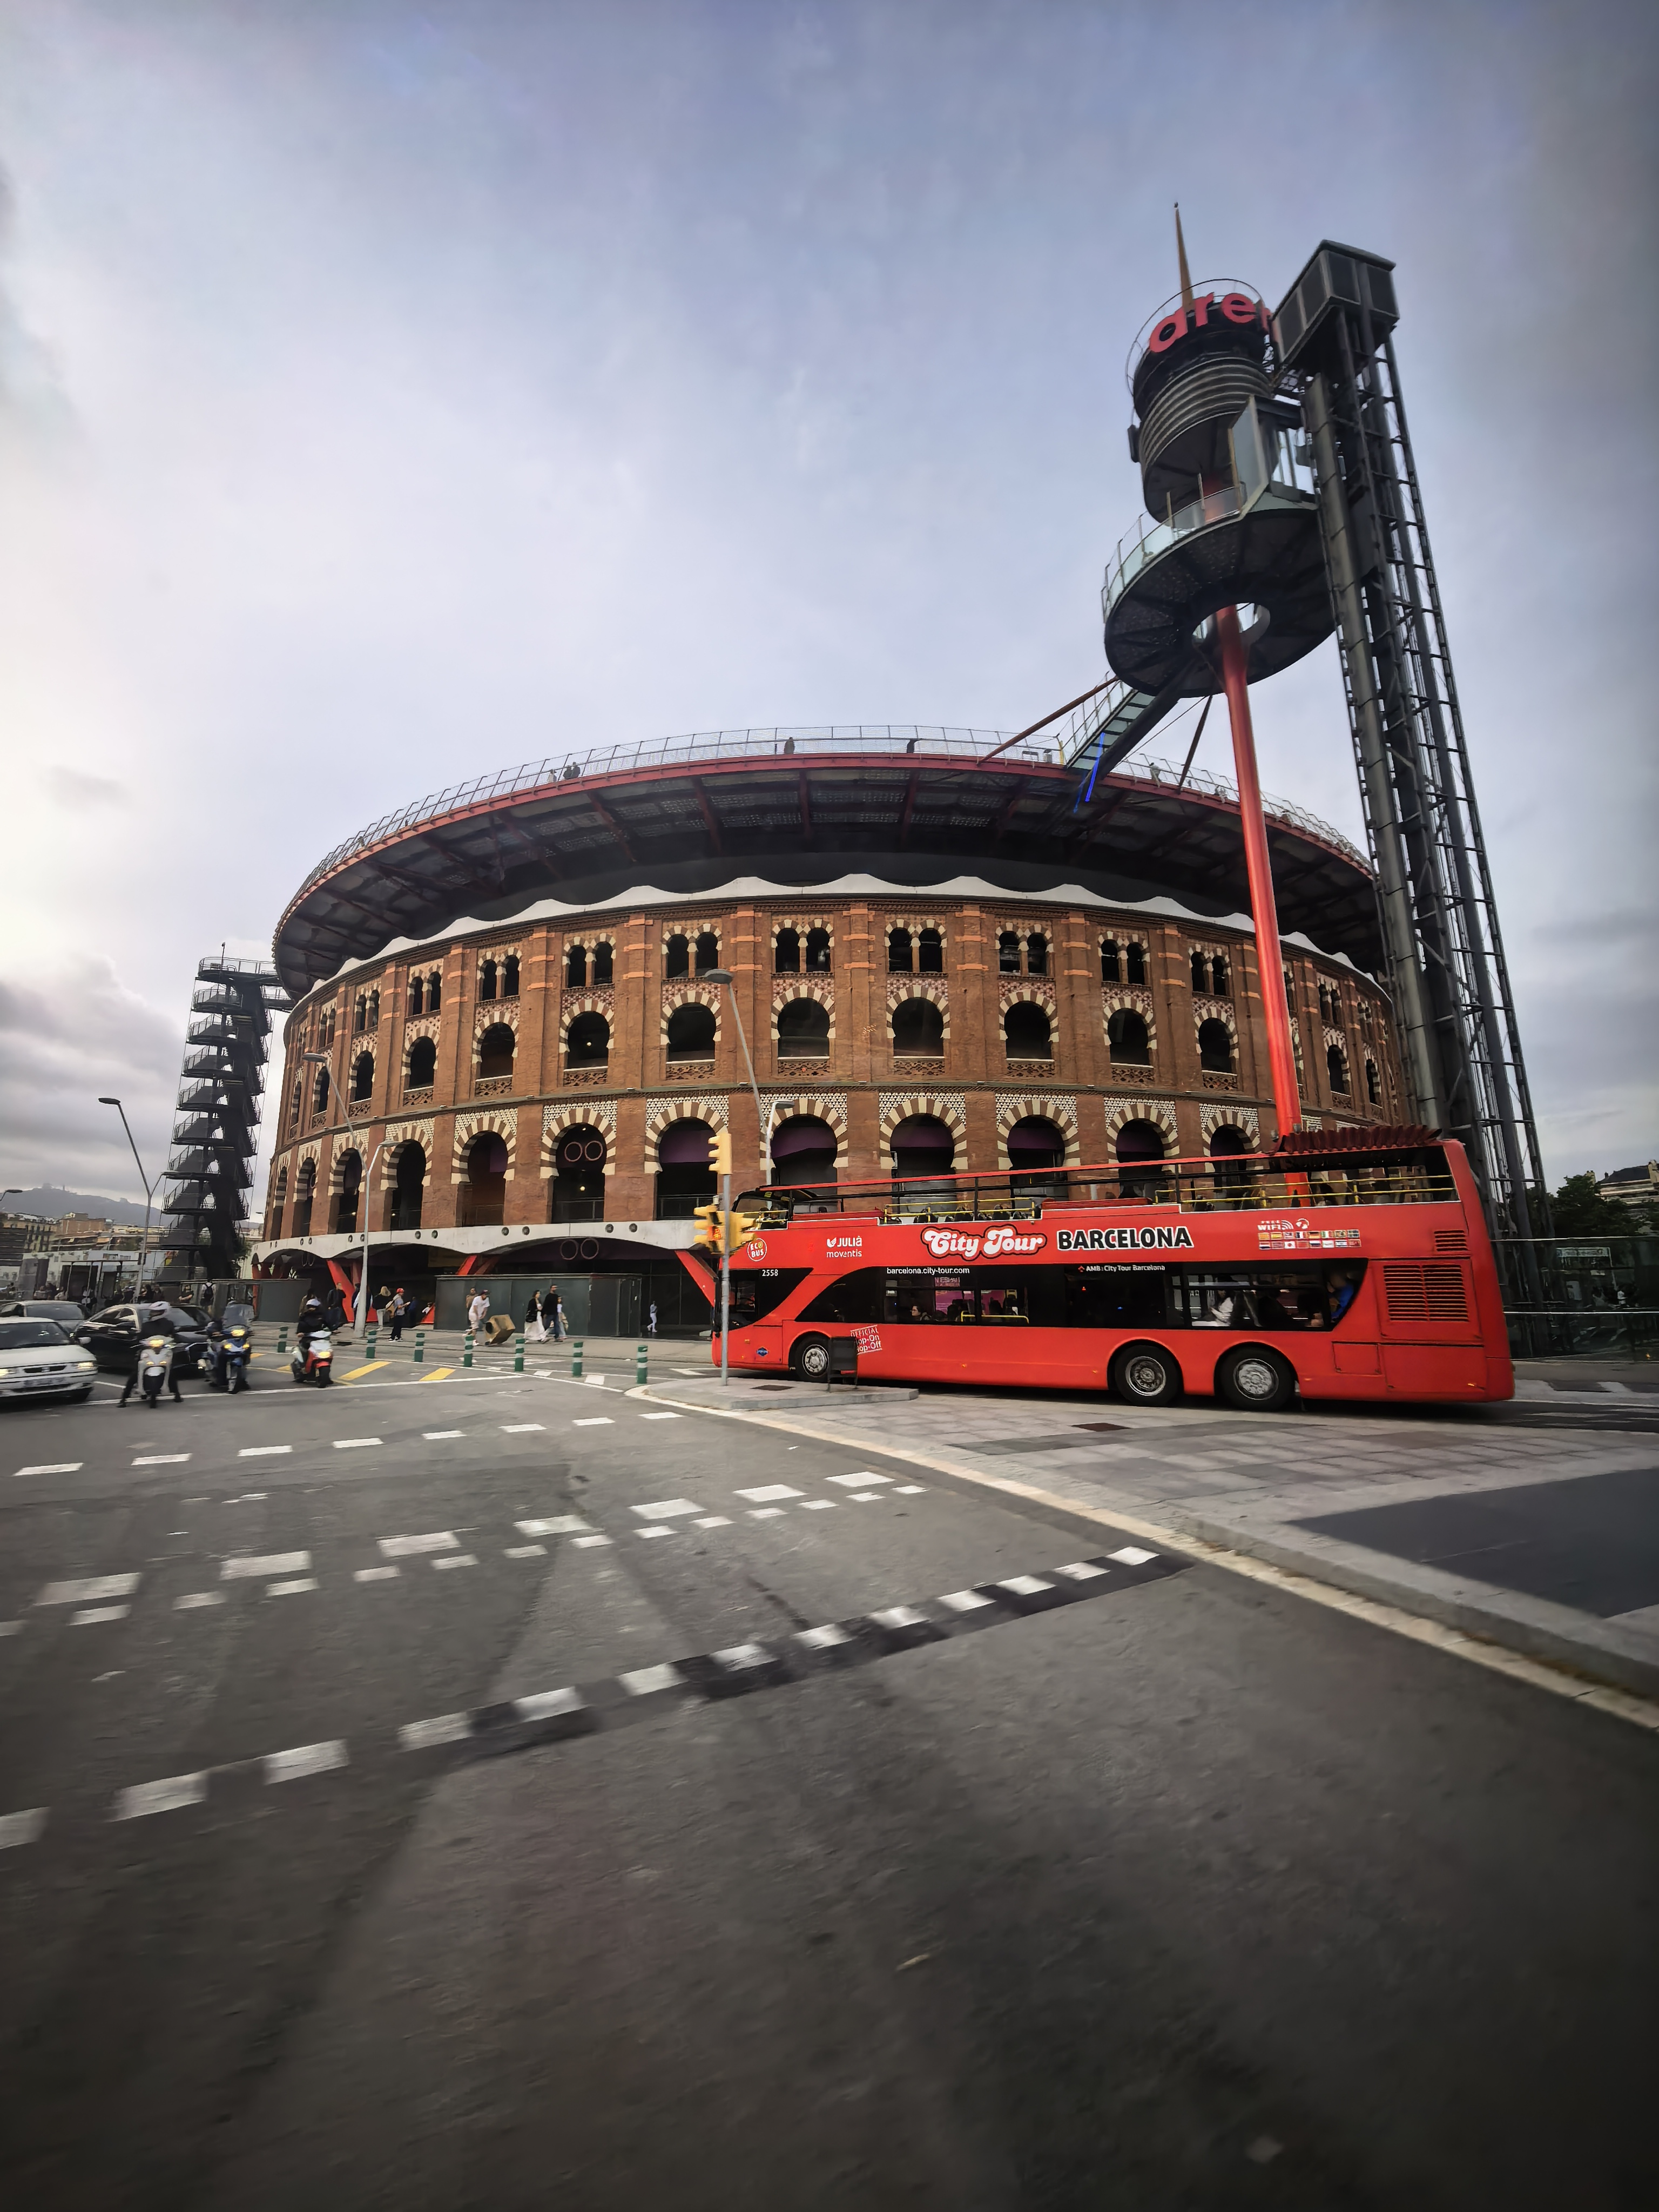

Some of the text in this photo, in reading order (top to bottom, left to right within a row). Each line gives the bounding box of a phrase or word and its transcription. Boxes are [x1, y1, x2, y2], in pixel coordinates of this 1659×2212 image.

[925, 1228, 1043, 1257] City Tour
[1057, 1226, 1194, 1251] BARCELONA
[751, 1242, 763, 1251] ECO
[751, 1249, 764, 1258] BUS
[887, 1267, 970, 1276] barcelona.city-tour.com
